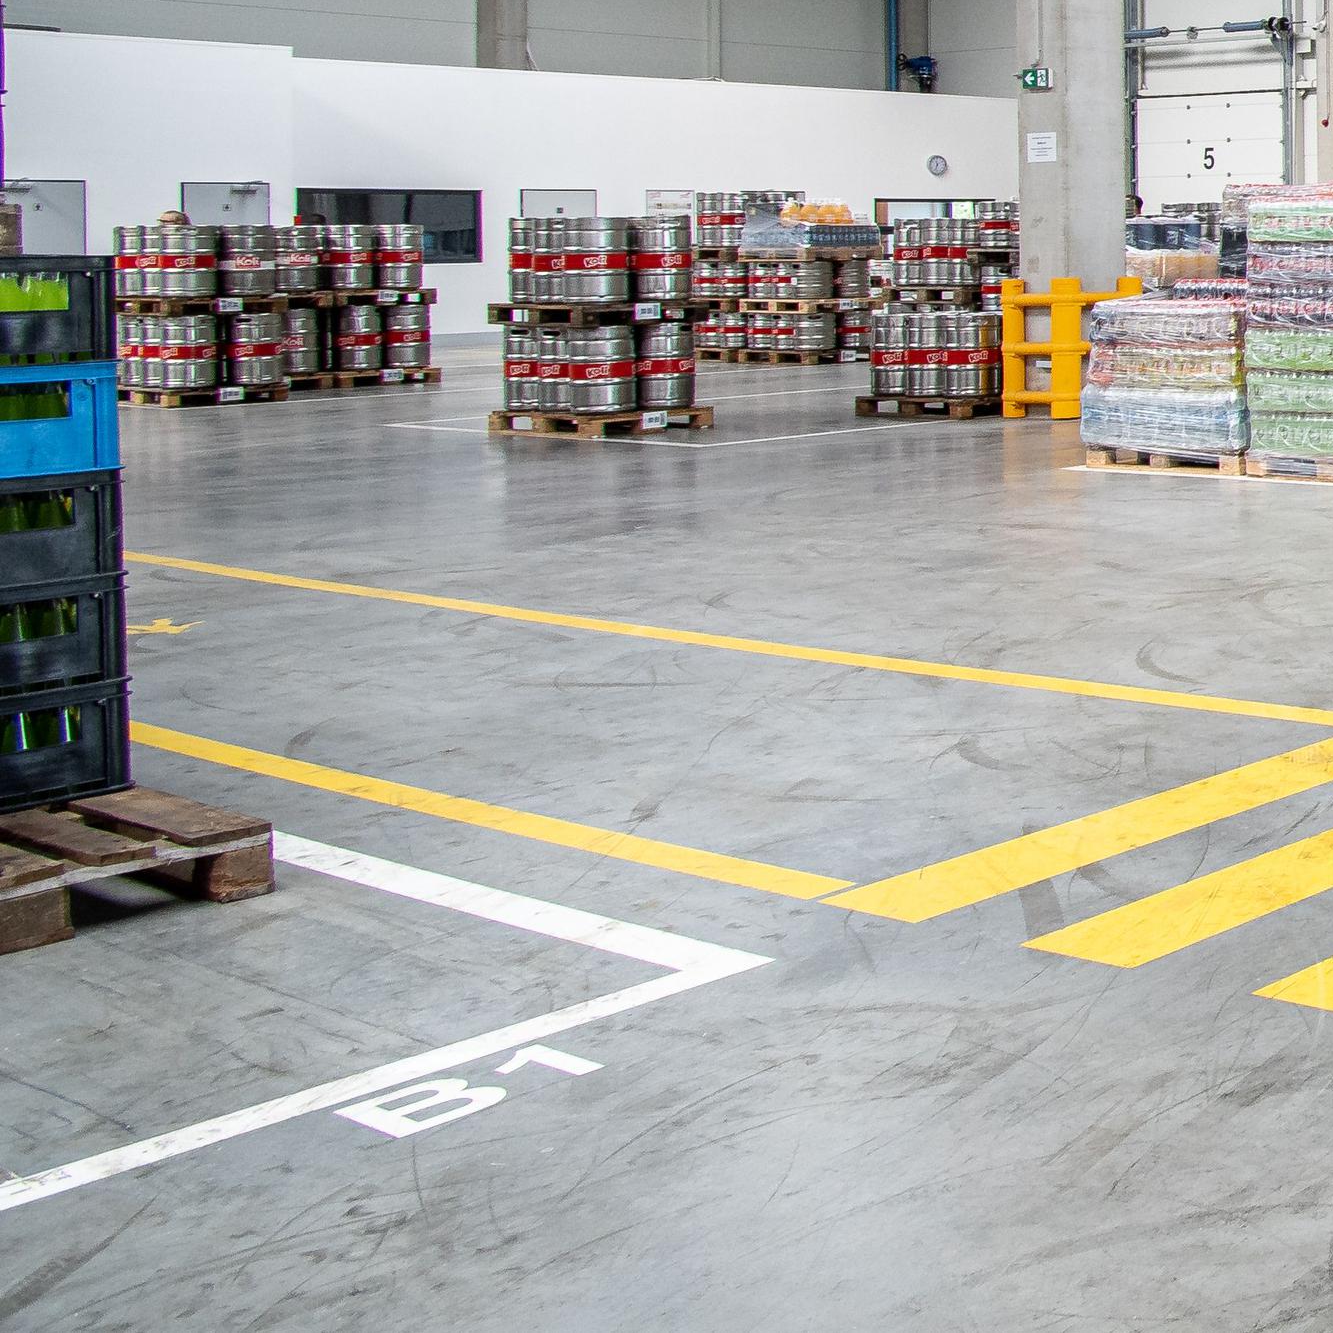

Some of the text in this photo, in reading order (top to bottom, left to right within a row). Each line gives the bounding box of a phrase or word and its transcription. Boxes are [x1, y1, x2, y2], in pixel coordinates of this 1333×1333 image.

[1203, 147, 1215, 170] 5
[968, 350, 988, 363] Koli
[333, 1044, 606, 1139] B1
